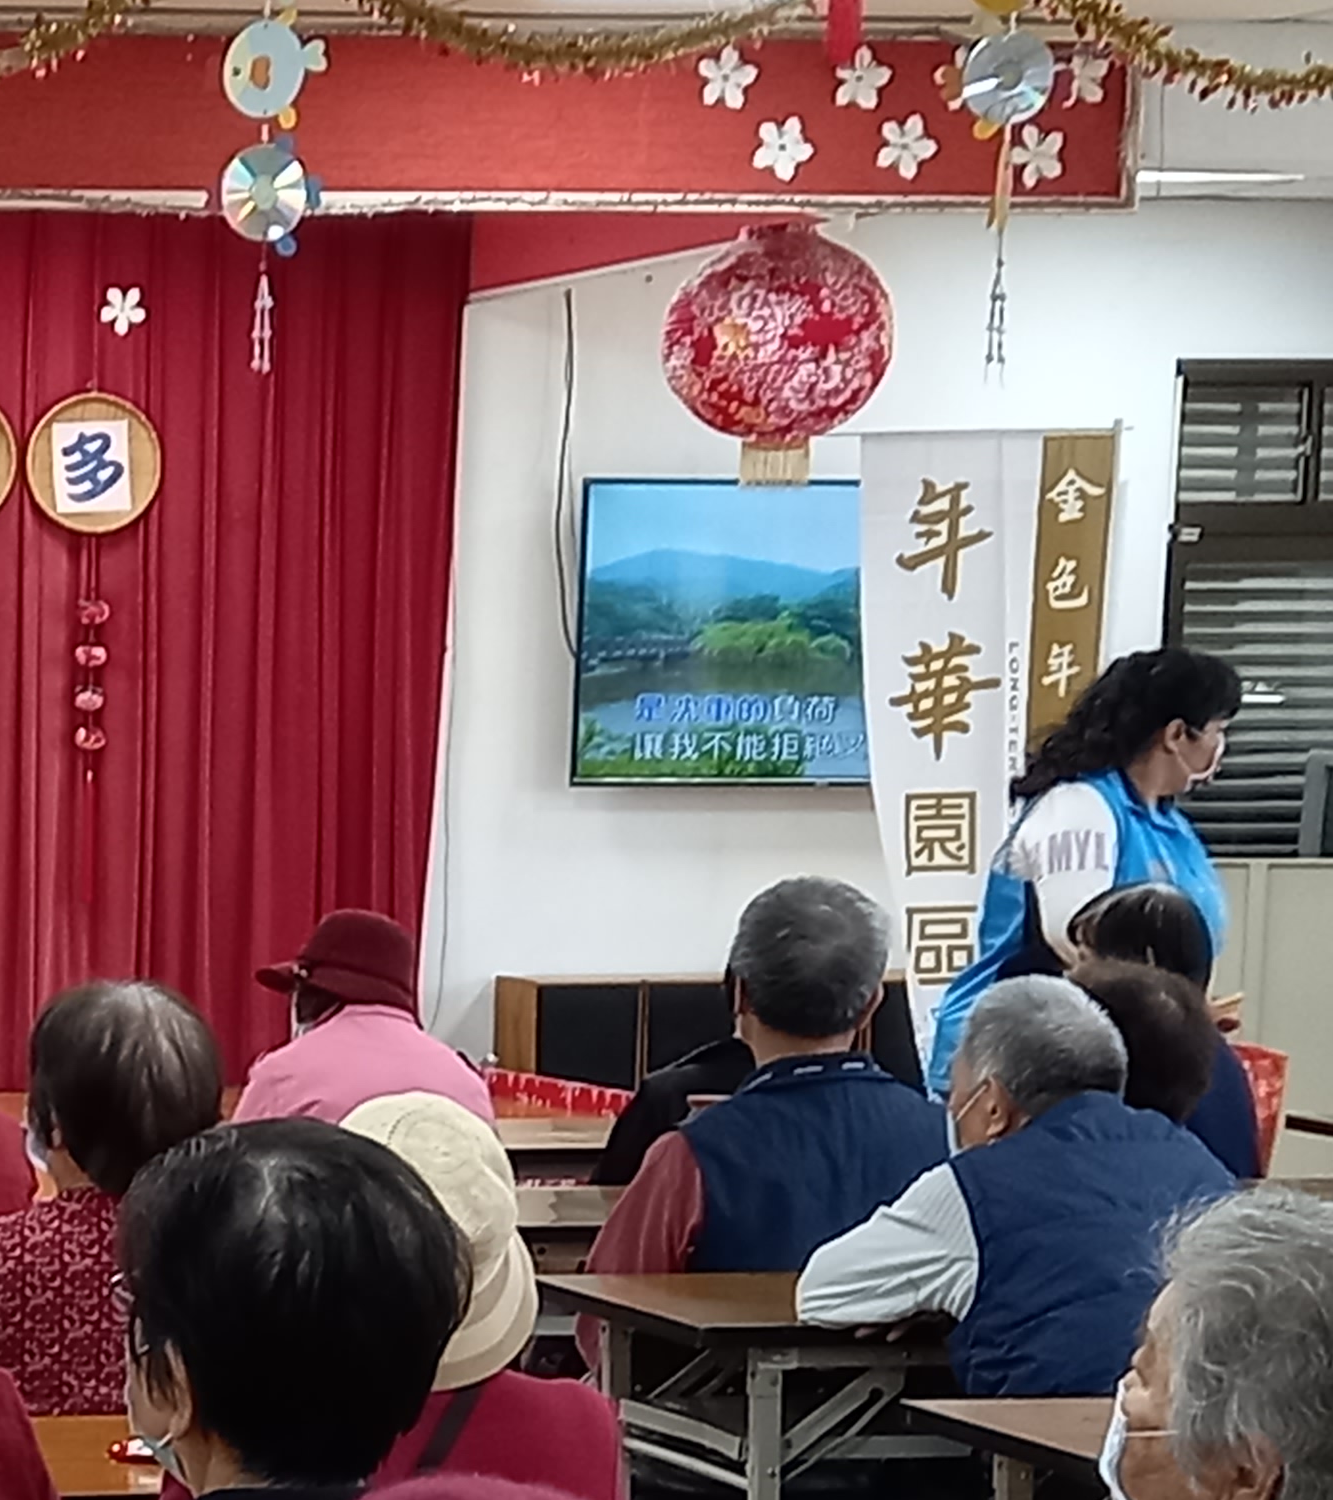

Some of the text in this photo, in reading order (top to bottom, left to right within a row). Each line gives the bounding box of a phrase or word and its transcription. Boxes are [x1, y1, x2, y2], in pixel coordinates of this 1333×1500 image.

[889, 476, 1002, 985] 年華園區
[1039, 466, 1107, 698] 金色年
